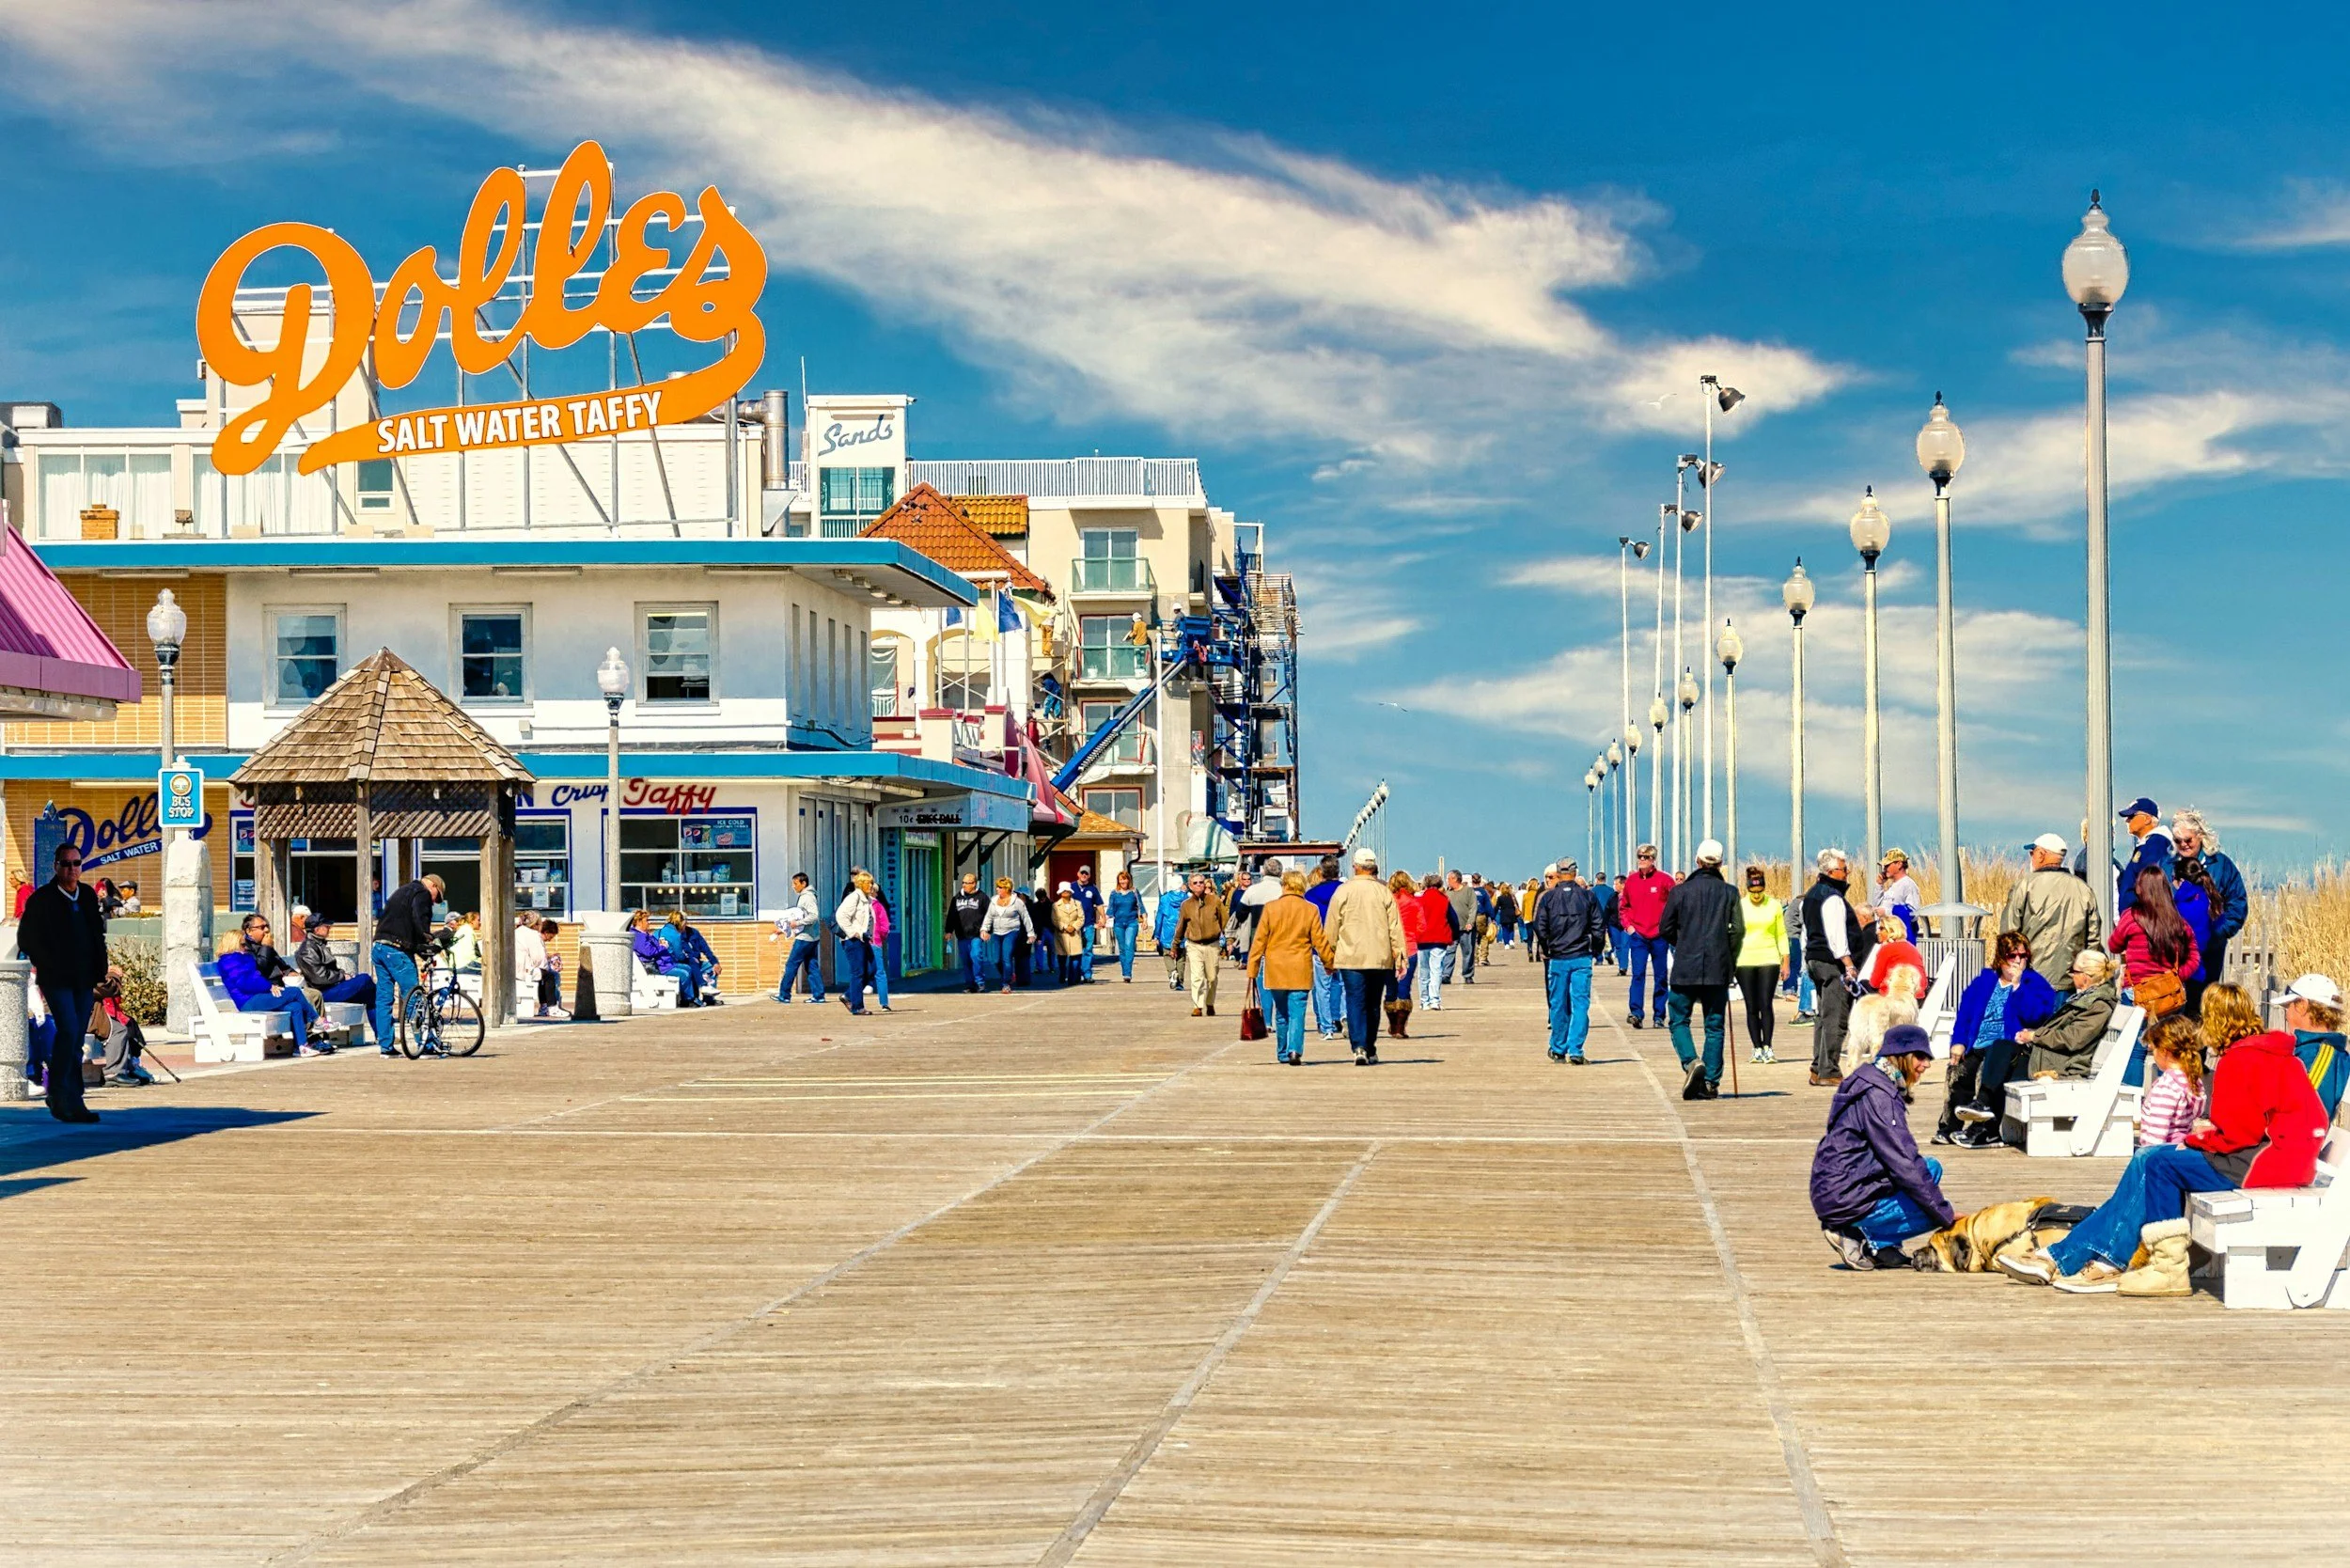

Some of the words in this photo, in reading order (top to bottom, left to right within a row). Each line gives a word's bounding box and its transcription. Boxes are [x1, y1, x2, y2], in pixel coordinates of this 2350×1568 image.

[377, 415, 448, 454] SALT
[454, 403, 563, 447] WATER
[567, 390, 663, 435] TAFFY
[818, 414, 894, 457] Sands
[168, 807, 195, 819] STOP
[171, 795, 192, 808] BUS
[623, 777, 717, 816] Taffy
[56, 792, 213, 859] Doll
[100, 852, 121, 866] SALT
[123, 841, 158, 857] WATER
